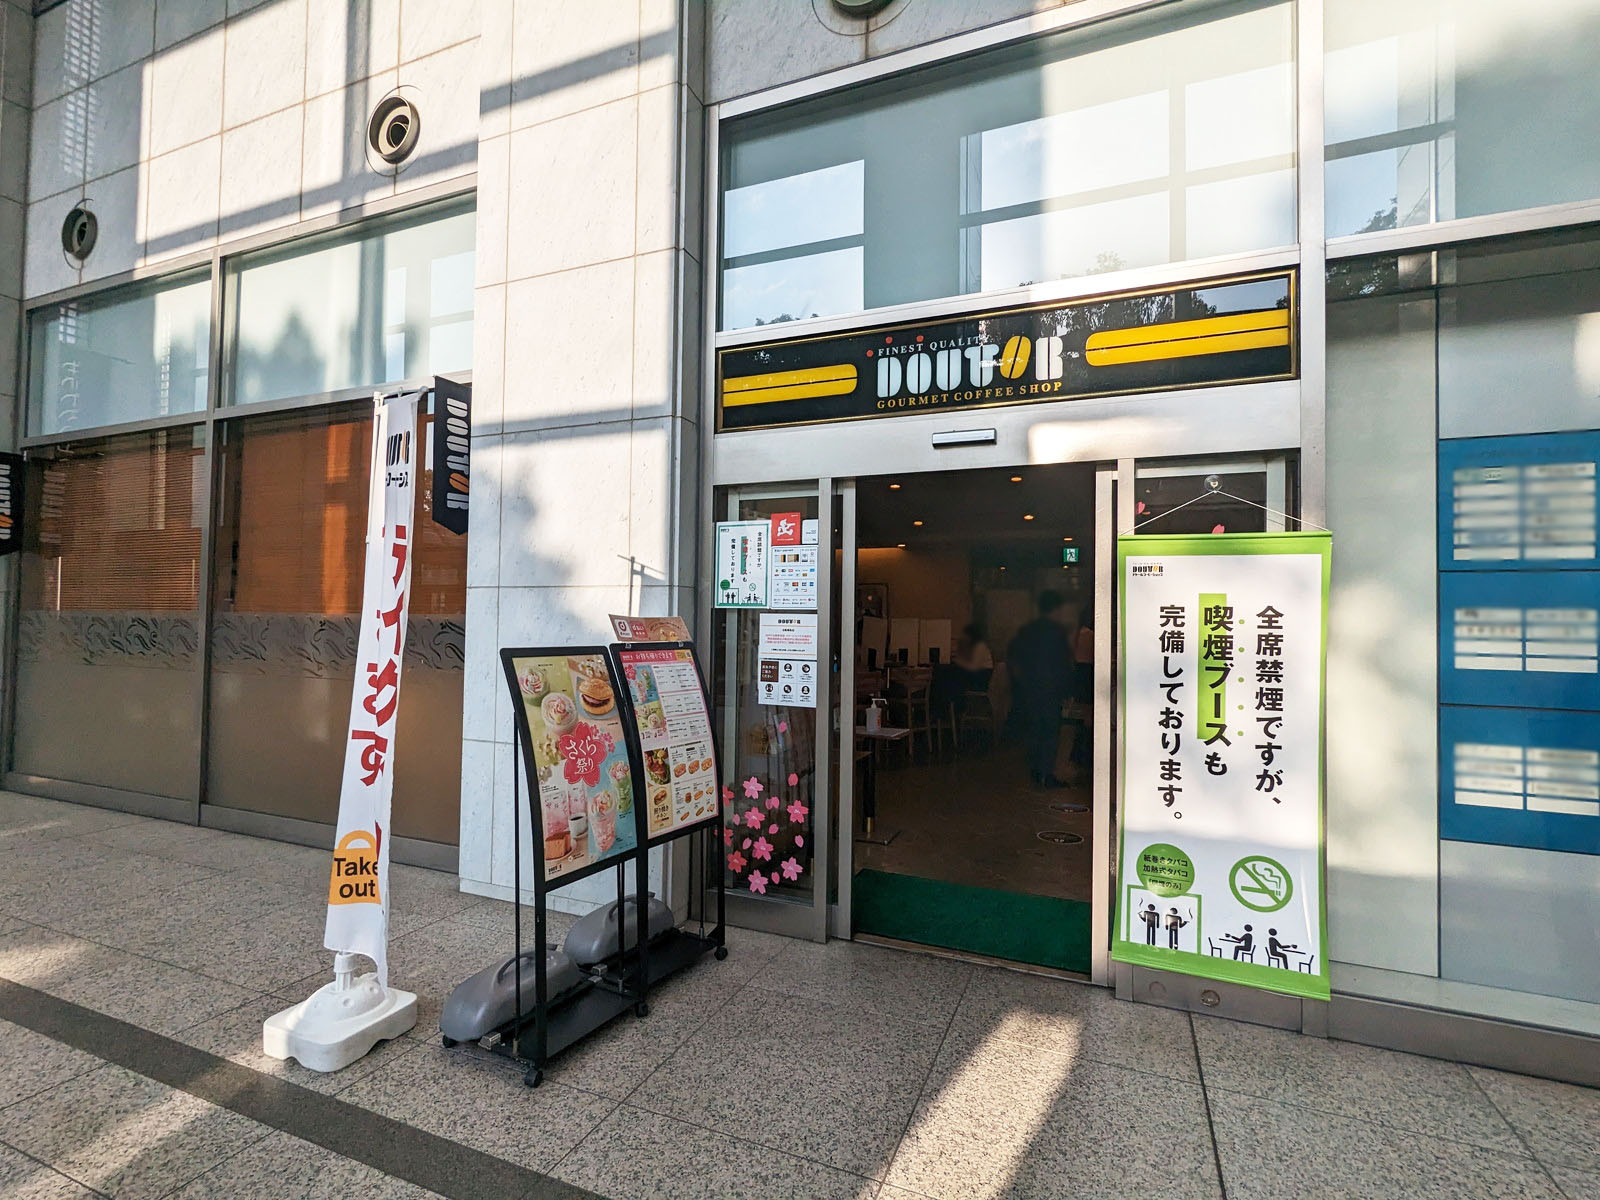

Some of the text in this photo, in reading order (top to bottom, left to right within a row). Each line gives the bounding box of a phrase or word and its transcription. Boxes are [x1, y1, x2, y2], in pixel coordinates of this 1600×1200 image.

[878, 343, 924, 356] FINEST
[877, 335, 1064, 398] DOUTOR
[877, 381, 1063, 409] GOURMET COFFEE SHOP
[446, 397, 470, 510] DOUTOR
[1203, 604, 1234, 777] 喫煙ブースも
[1157, 604, 1186, 820] 完備しております。
[1255, 605, 1285, 805] 全席禁煙ですが、
[565, 735, 597, 760] さくら
[576, 757, 595, 774] 祭り
[1143, 864, 1188, 878] 加熱式タバコ
[339, 880, 376, 899] out
